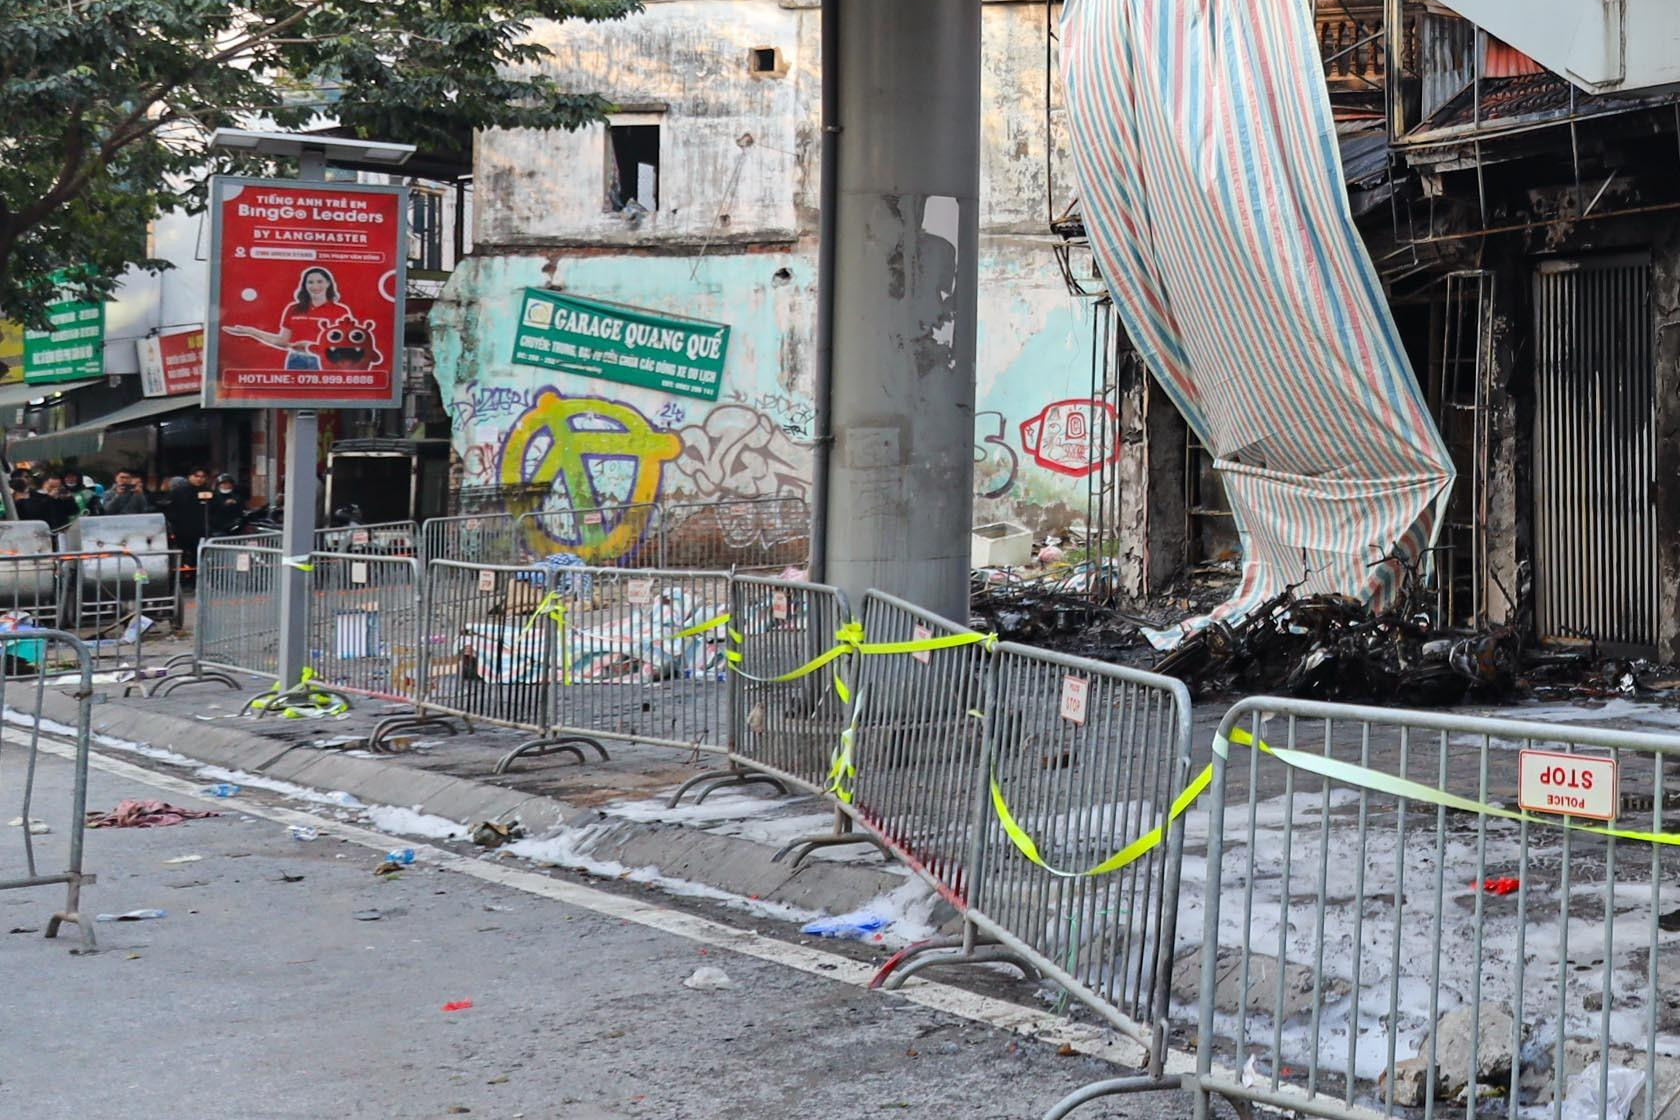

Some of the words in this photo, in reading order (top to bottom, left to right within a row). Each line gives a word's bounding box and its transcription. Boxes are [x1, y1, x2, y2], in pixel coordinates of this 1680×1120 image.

[297, 196, 322, 207] ANH
[350, 200, 367, 209] EM
[238, 203, 307, 221] BingGo
[312, 208, 384, 223] Leaders
[254, 230, 270, 239] BY
[275, 231, 368, 243] LANGMASTER
[555, 308, 622, 342] GARAGE
[624, 323, 684, 353] QUANG
[687, 328, 725, 360] QUẾ
[238, 373, 295, 384] HOTLINE:
[1540, 766, 1593, 790] STOP
[1547, 794, 1585, 809] POLICE
